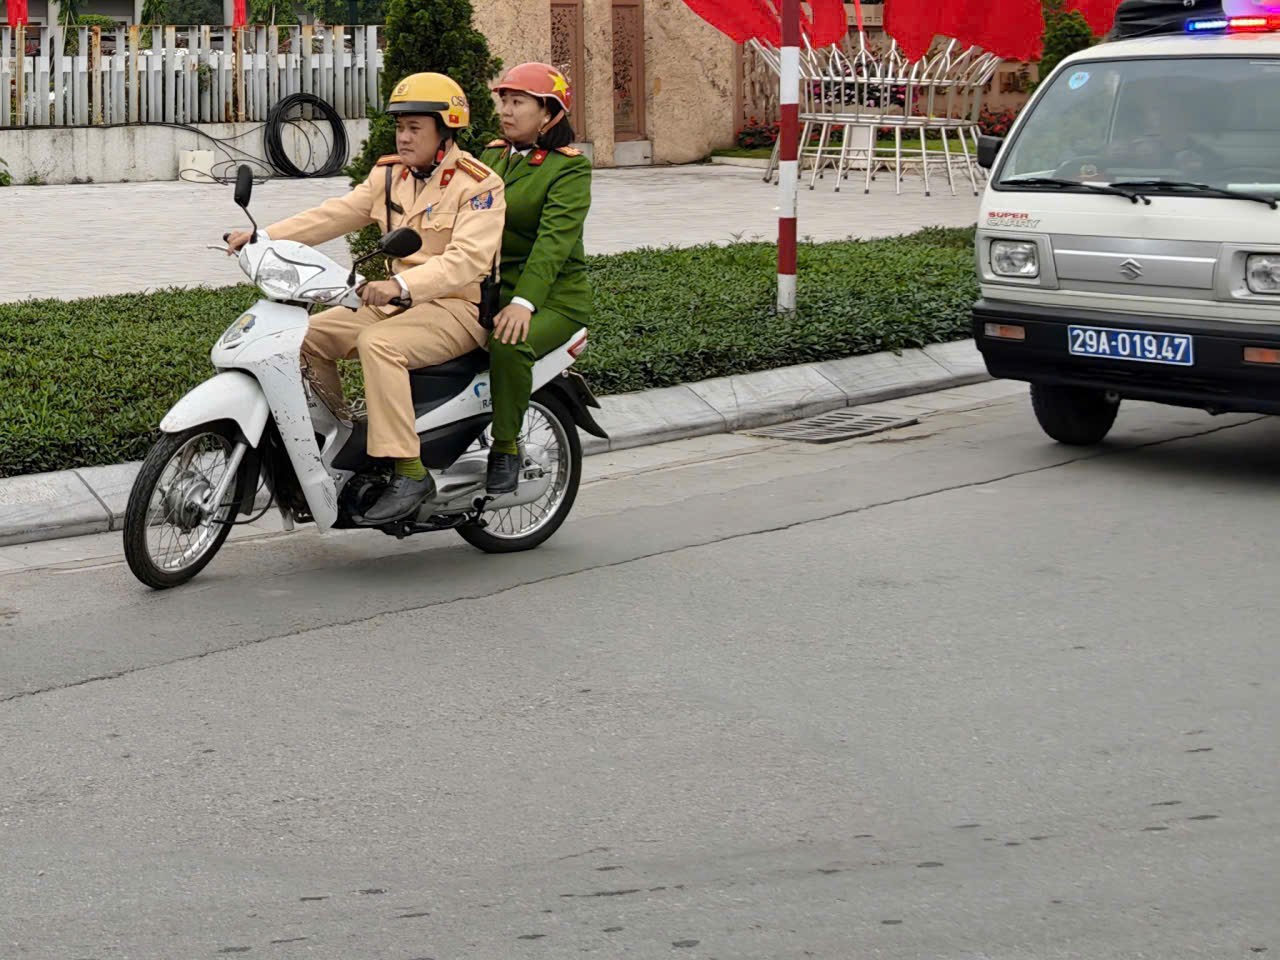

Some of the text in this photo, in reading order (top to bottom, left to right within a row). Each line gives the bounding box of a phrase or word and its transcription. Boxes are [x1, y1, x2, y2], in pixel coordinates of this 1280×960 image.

[988, 211, 1029, 219] SUPER
[987, 218, 1040, 229] CARRY
[1071, 329, 1189, 361] 29A-019.47
